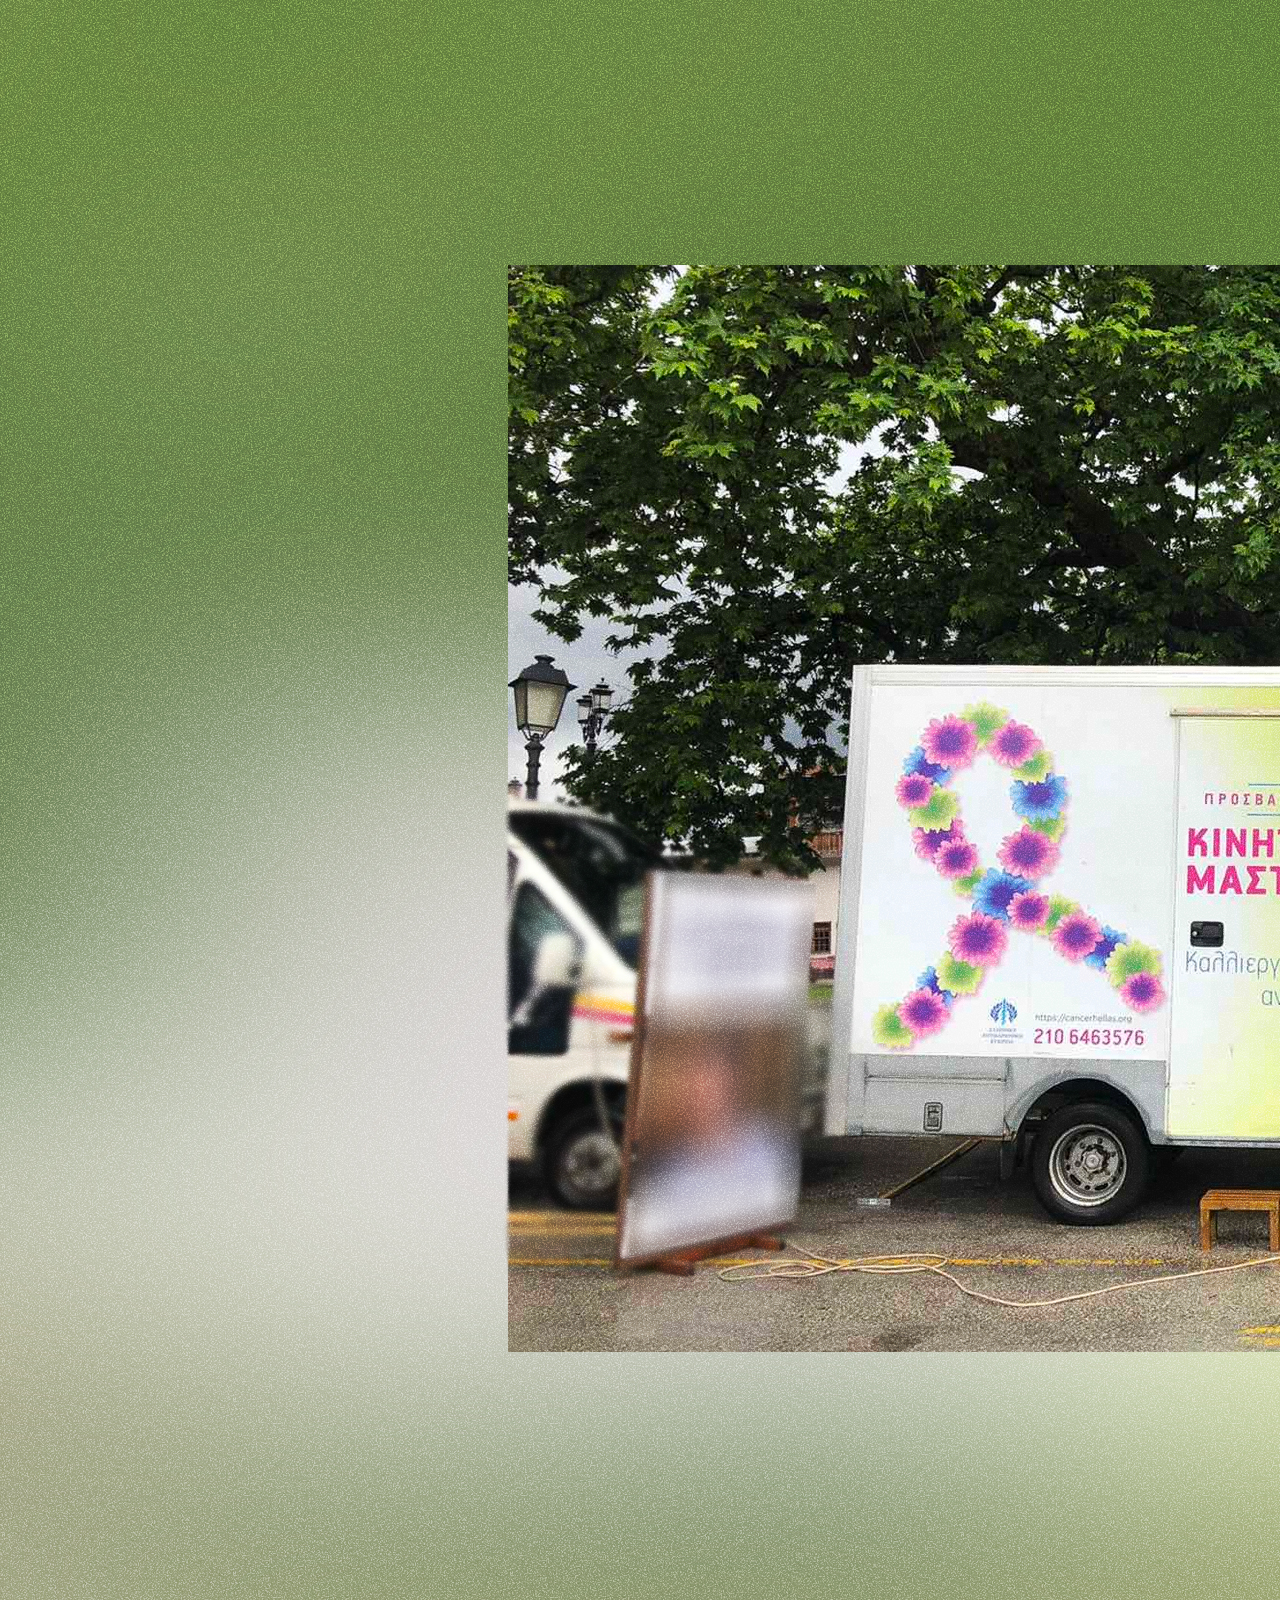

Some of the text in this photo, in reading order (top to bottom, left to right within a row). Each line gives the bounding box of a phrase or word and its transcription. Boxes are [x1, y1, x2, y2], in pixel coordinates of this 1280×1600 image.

[1034, 1013, 1133, 1024] https://cancerhellas.org
[1033, 1028, 1145, 1046] 210 6463576
